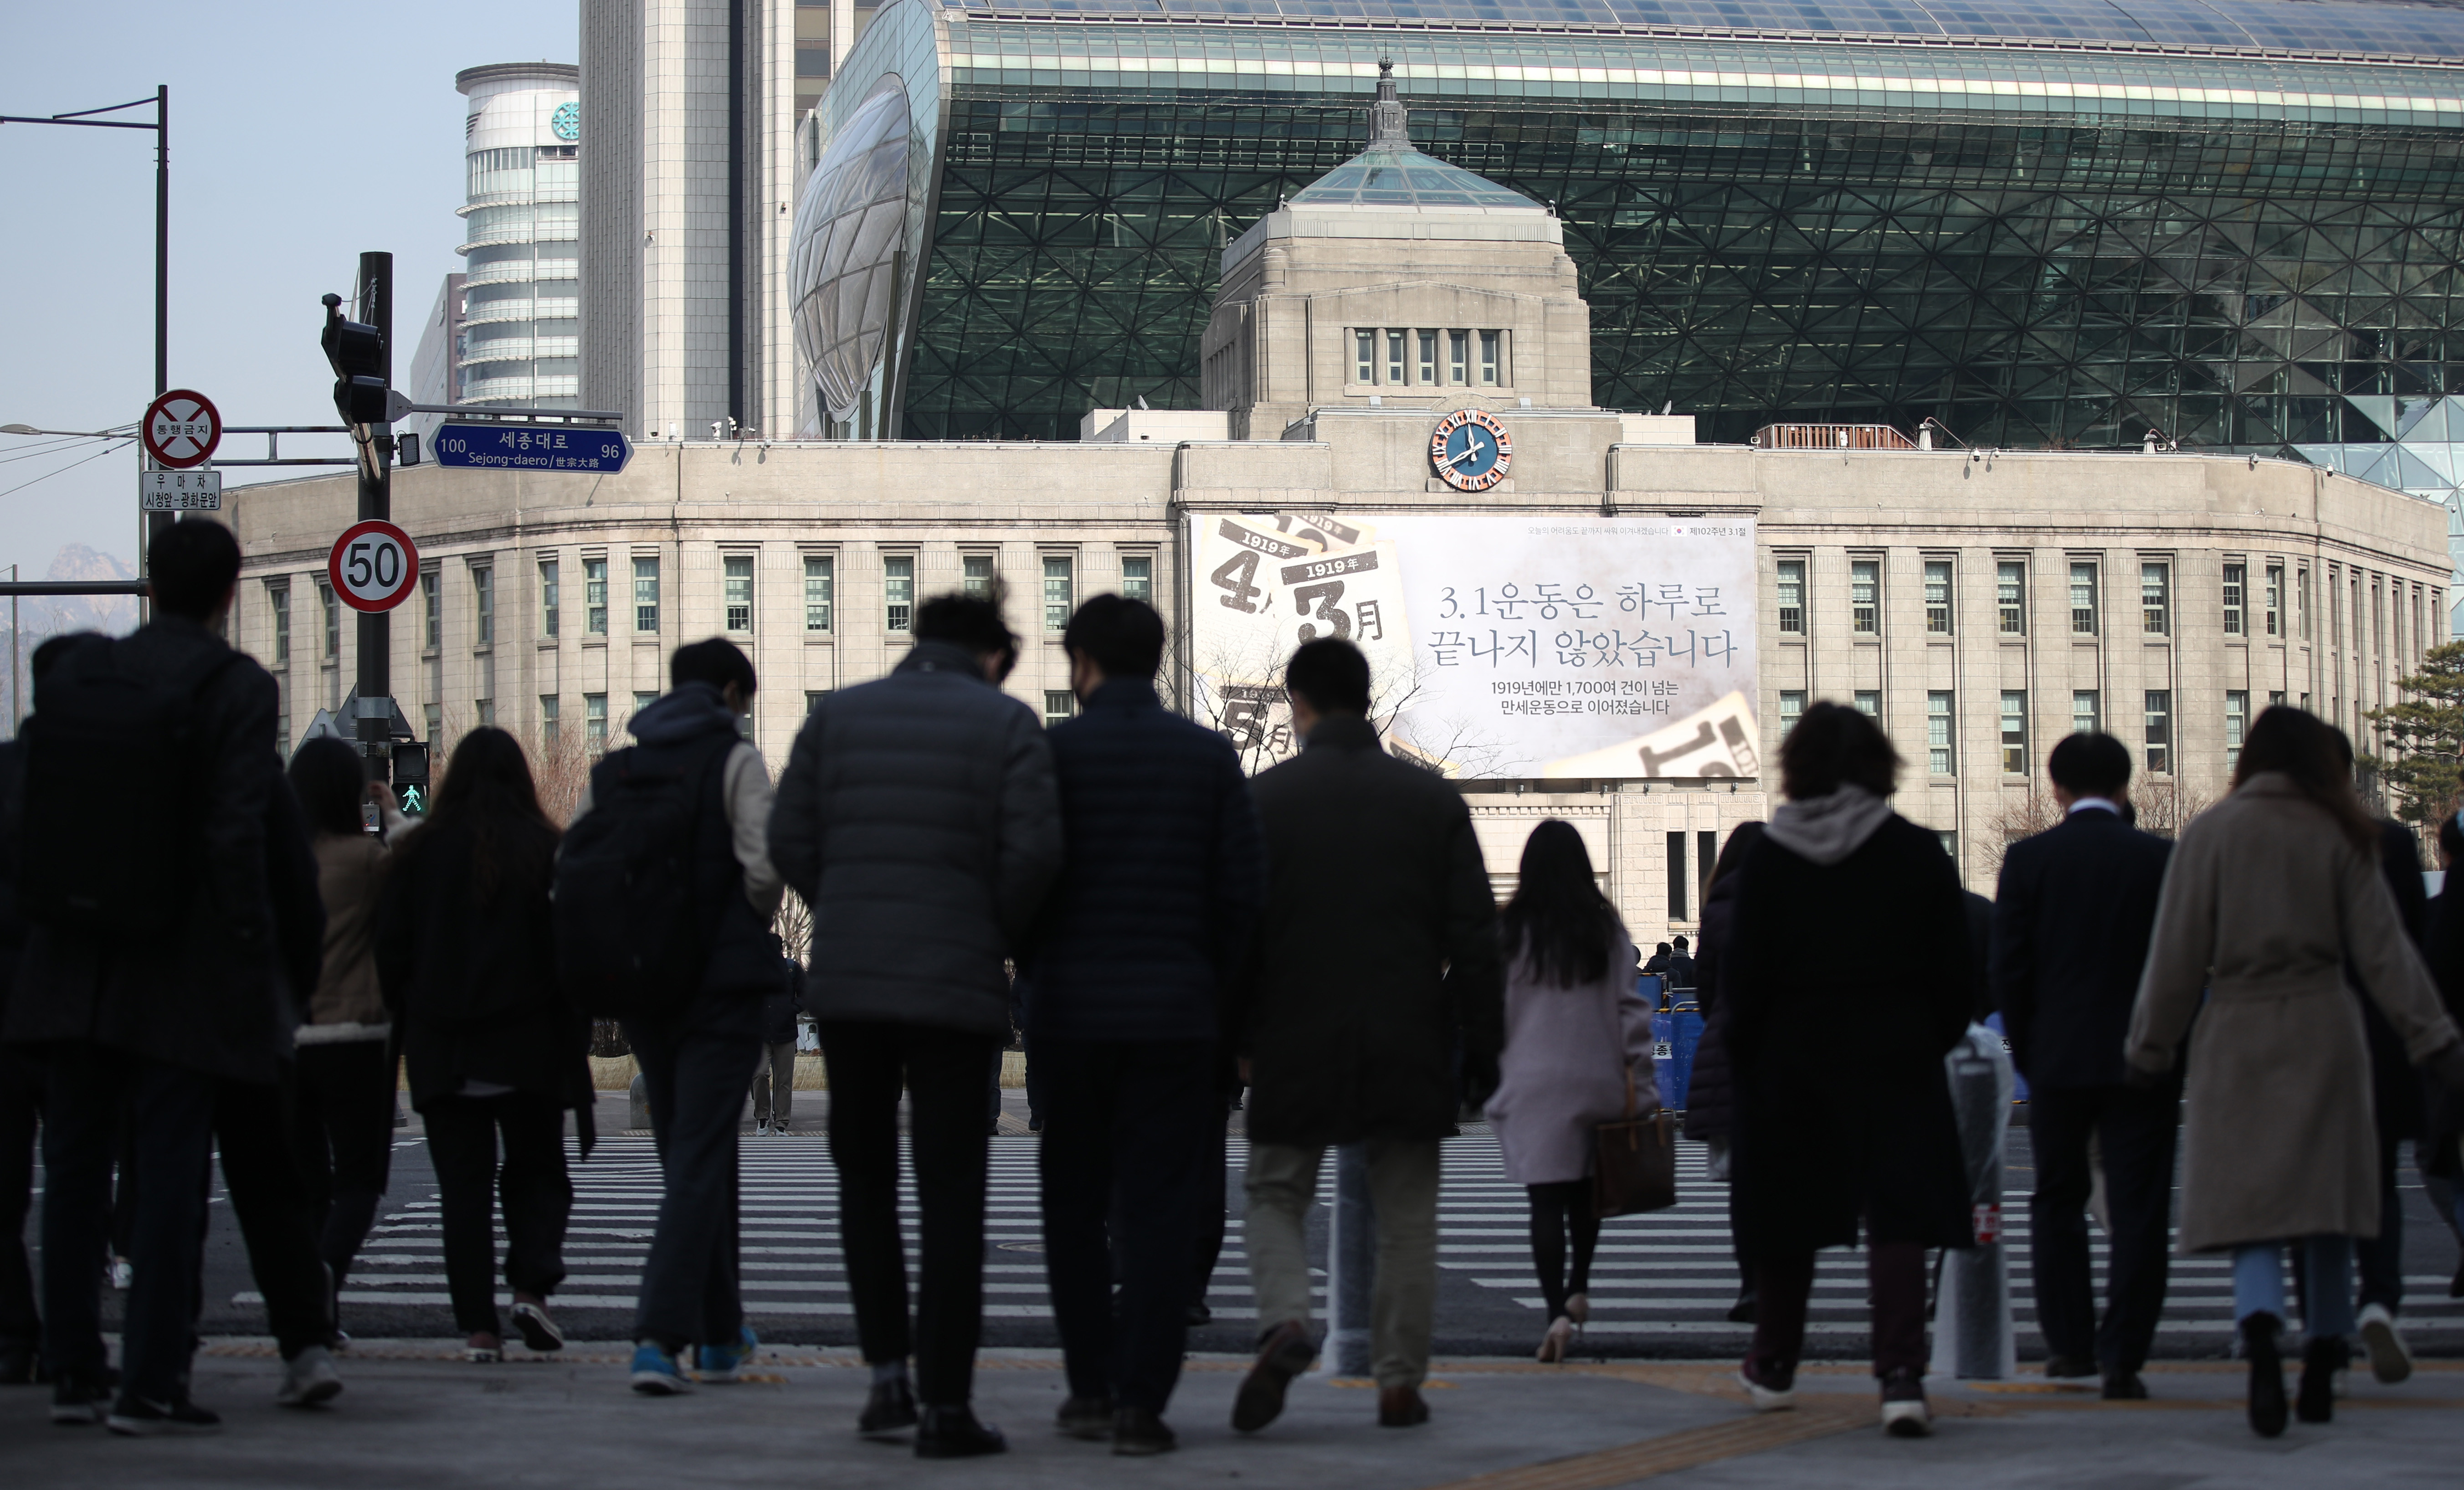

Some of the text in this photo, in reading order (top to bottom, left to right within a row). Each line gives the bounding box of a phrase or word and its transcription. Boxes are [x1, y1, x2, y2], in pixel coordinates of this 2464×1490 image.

[157, 425, 208, 435] 통행금지
[441, 439, 466, 453] 100
[499, 432, 569, 450] 세종대로
[601, 445, 619, 458] 96
[1528, 526, 1668, 536] 오늘의 어려움도 끝까지 싸워 이겨내겠습니다
[1689, 527, 1746, 537] 제102주년 3.1절
[348, 542, 399, 588] 50
[1306, 558, 1359, 578] 1919年
[1440, 581, 1727, 621] 3.1운동은 하루로
[1427, 629, 1738, 668] 끝나지 않았습니다
[1491, 680, 1679, 697] 1919년에만 1,700여 건이 넘는
[1501, 699, 1670, 715] 만세운동으로 이어졌습니다
